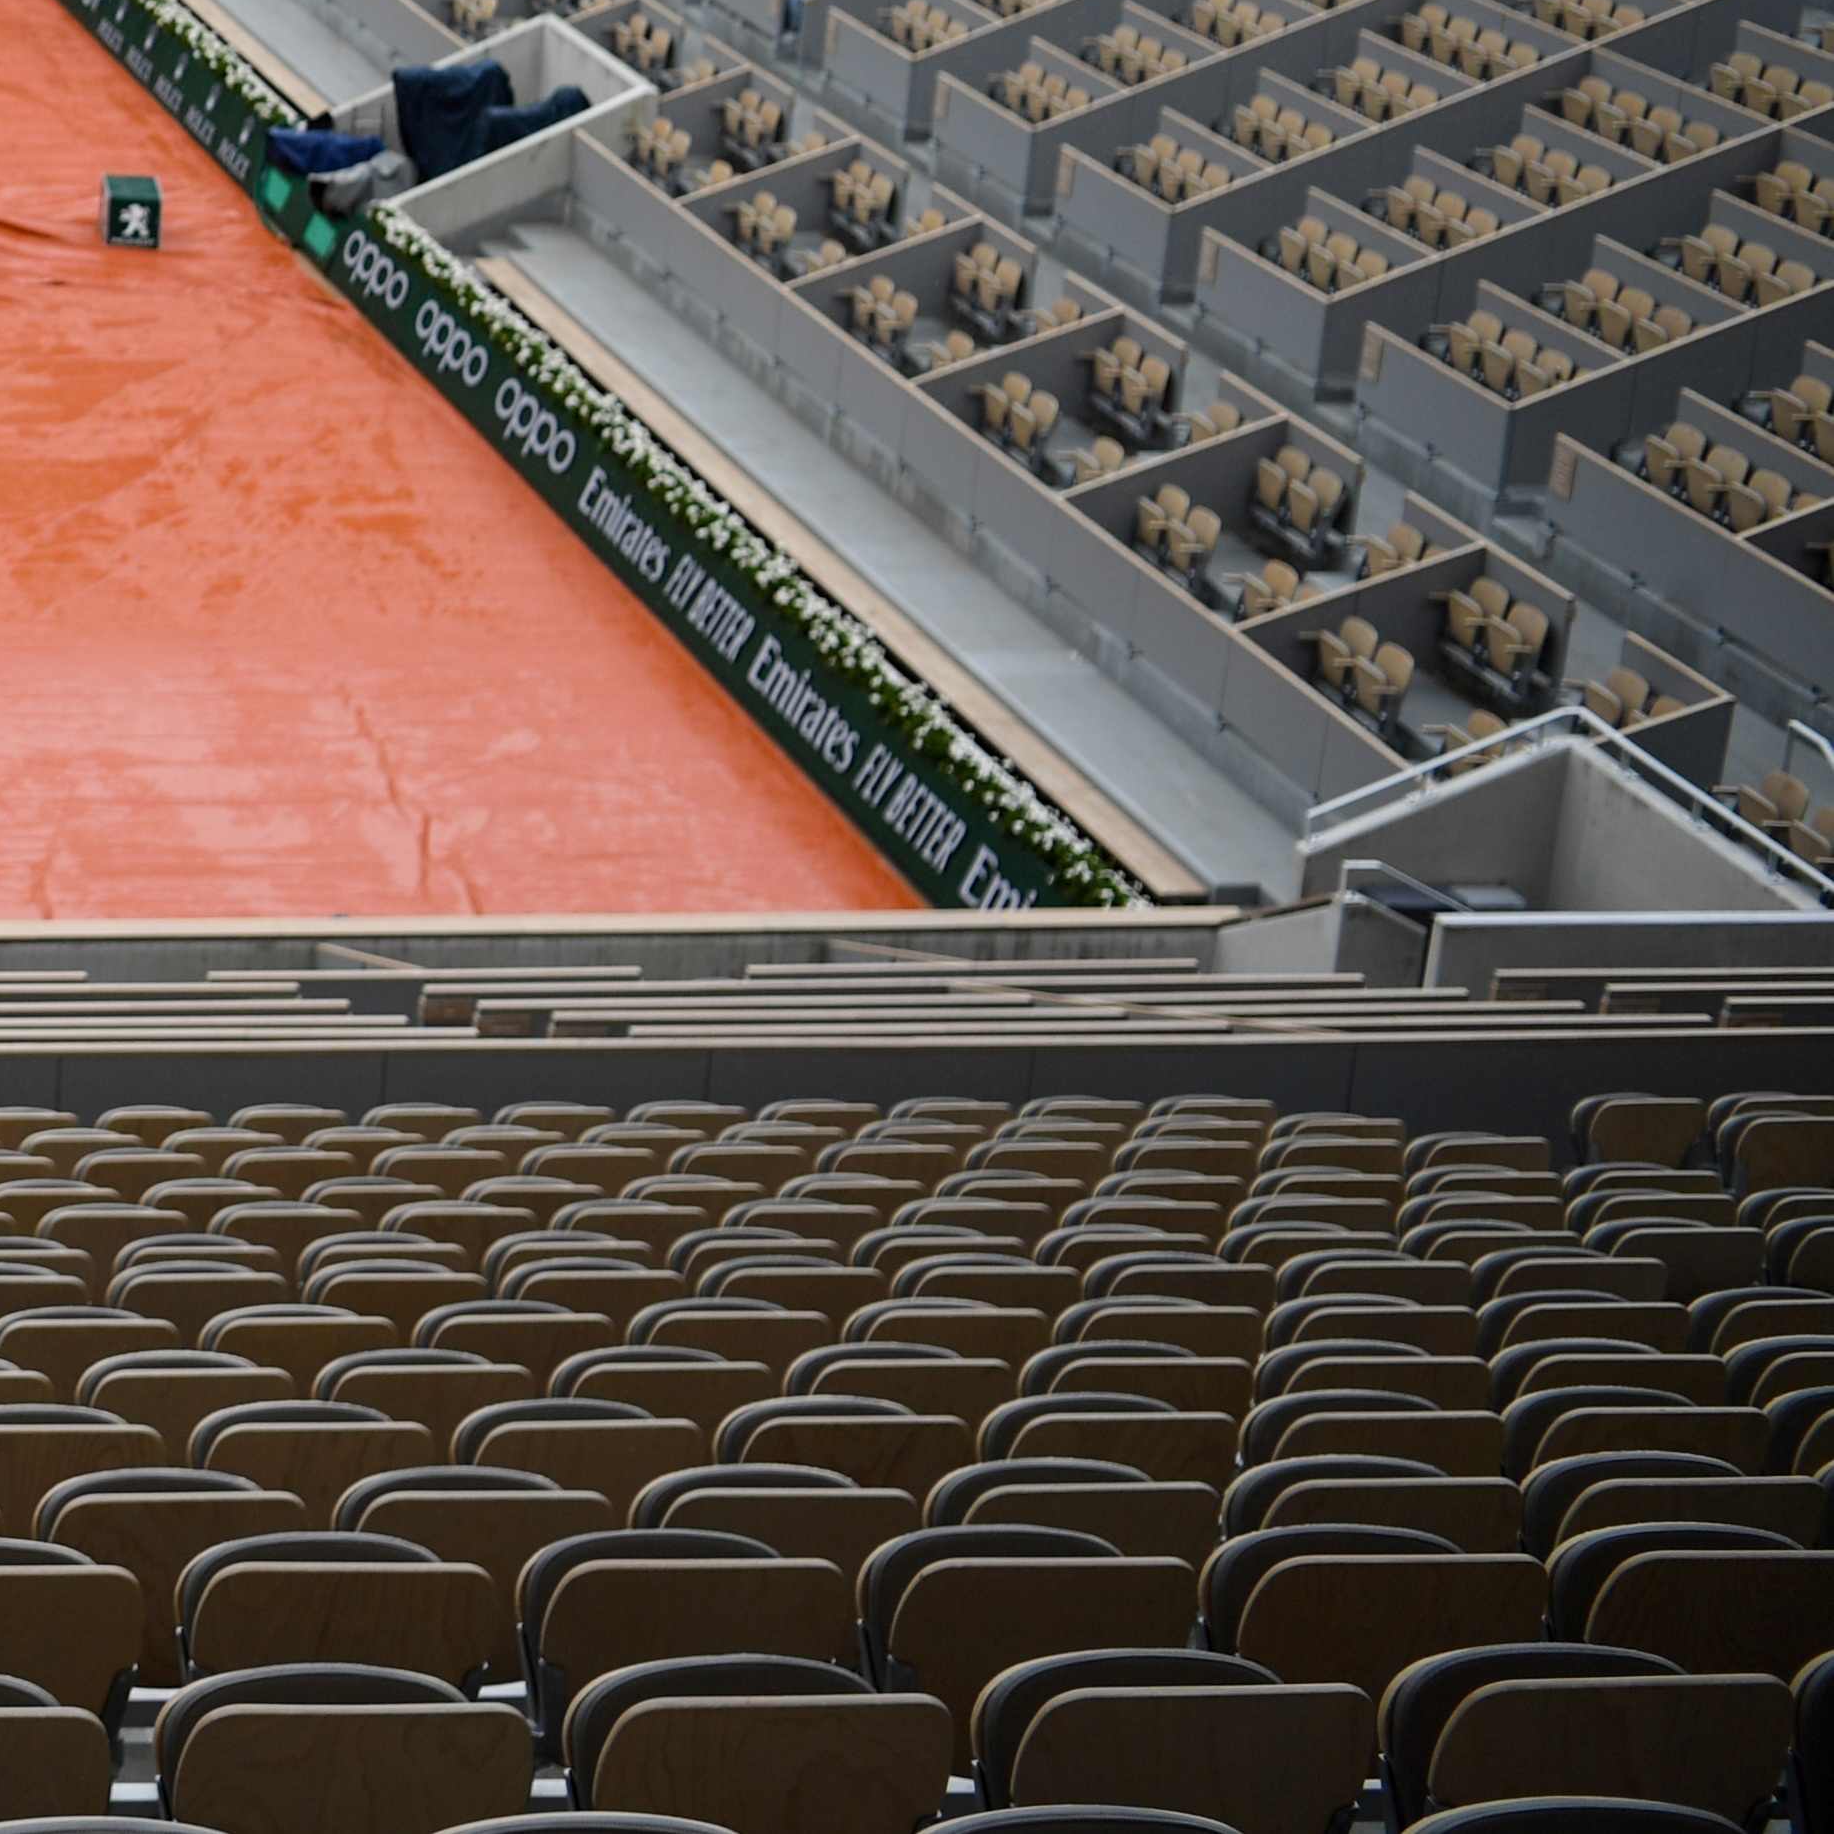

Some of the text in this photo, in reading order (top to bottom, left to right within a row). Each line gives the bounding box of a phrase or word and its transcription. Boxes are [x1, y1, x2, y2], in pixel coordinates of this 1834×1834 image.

[343, 229, 576, 473] oppo oppo oppo
[578, 465, 671, 583] Emirates
[663, 553, 706, 612] FLY
[687, 577, 756, 663] BETTER
[747, 633, 860, 773] Emirates
[852, 743, 904, 809] FLY
[884, 772, 967, 874] BETTER
